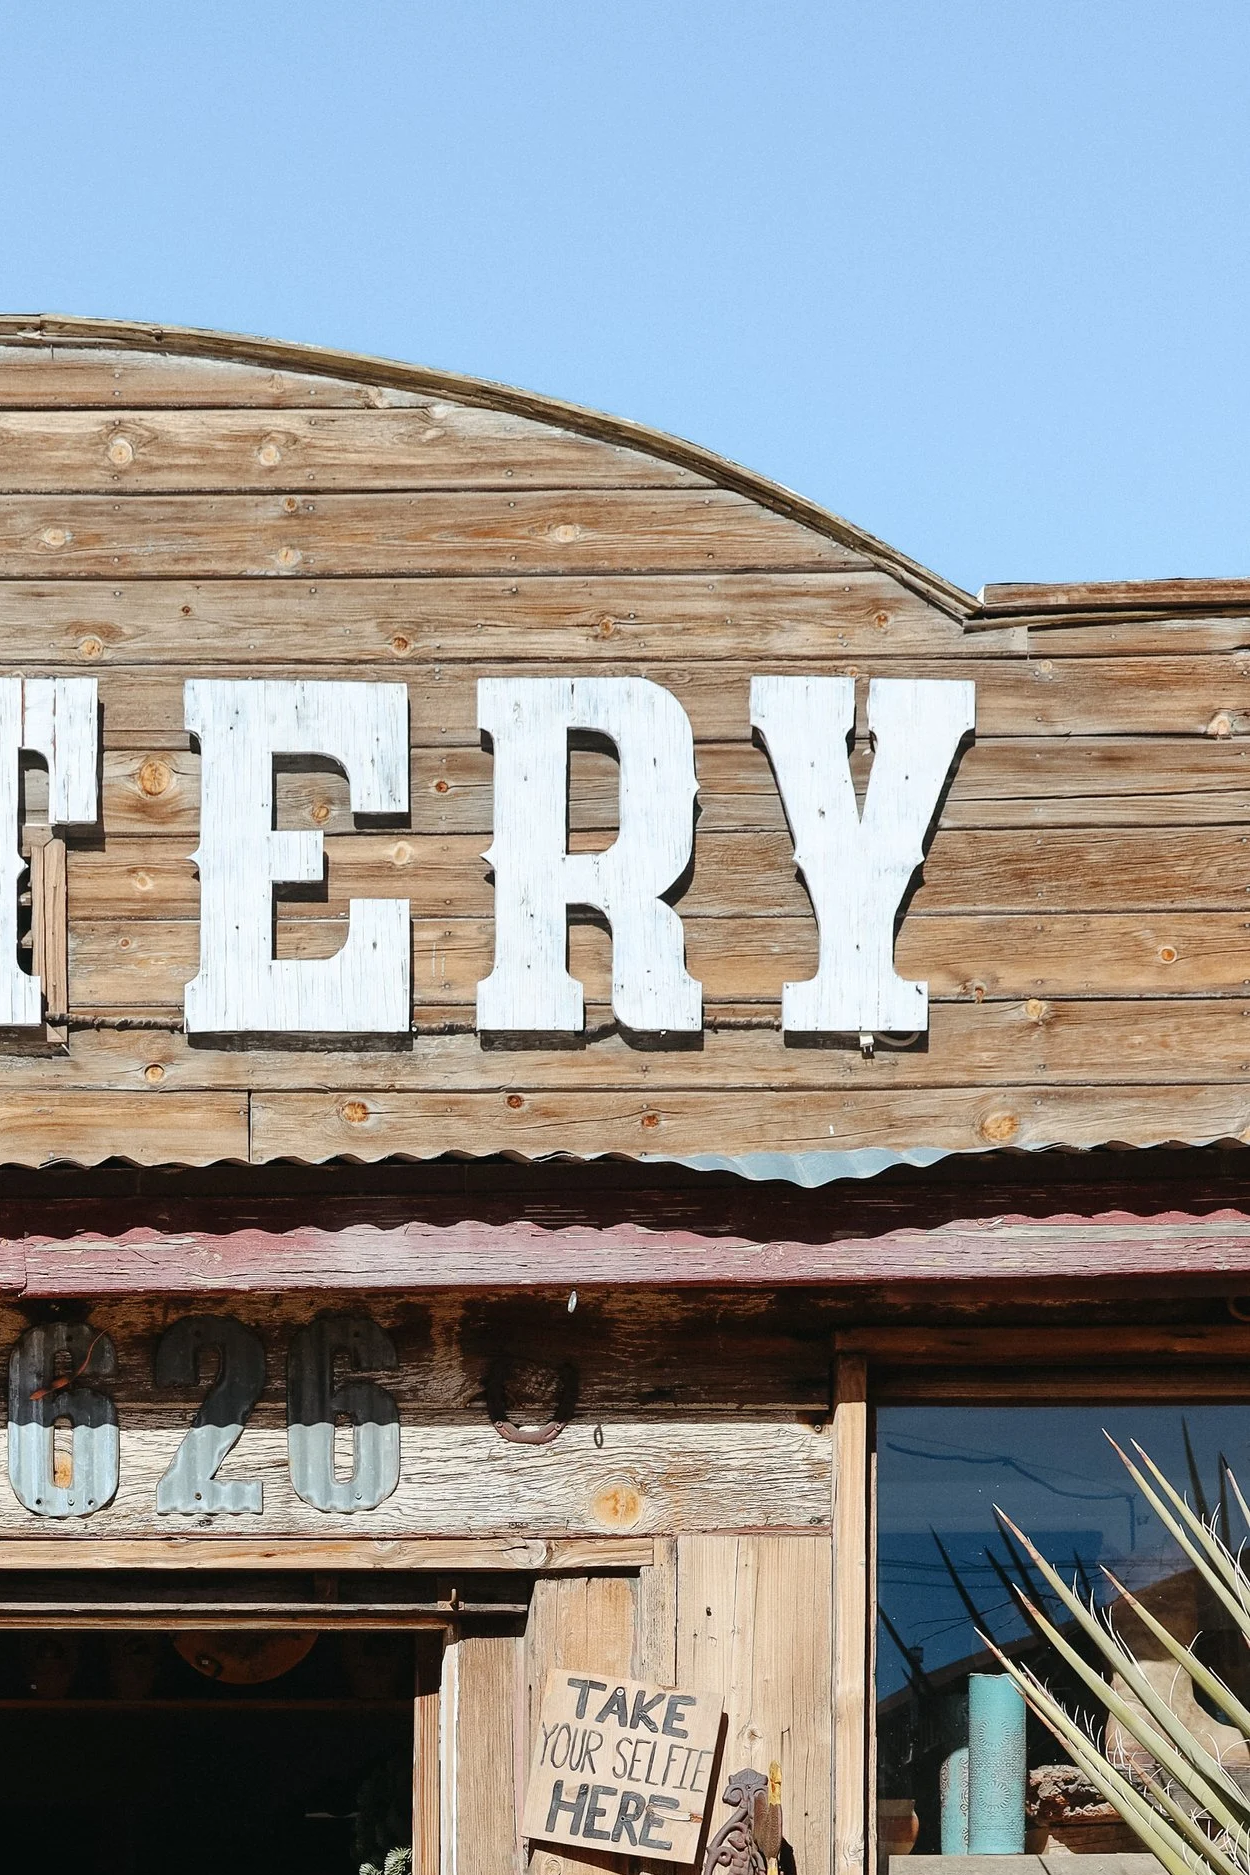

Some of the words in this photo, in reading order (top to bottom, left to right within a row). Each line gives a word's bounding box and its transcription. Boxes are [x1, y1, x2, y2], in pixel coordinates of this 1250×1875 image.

[566, 1677, 697, 1739] TAKE
[540, 1721, 604, 1775] YOUR
[612, 1736, 715, 1793] SELFIE
[545, 1779, 680, 1851] HERE
